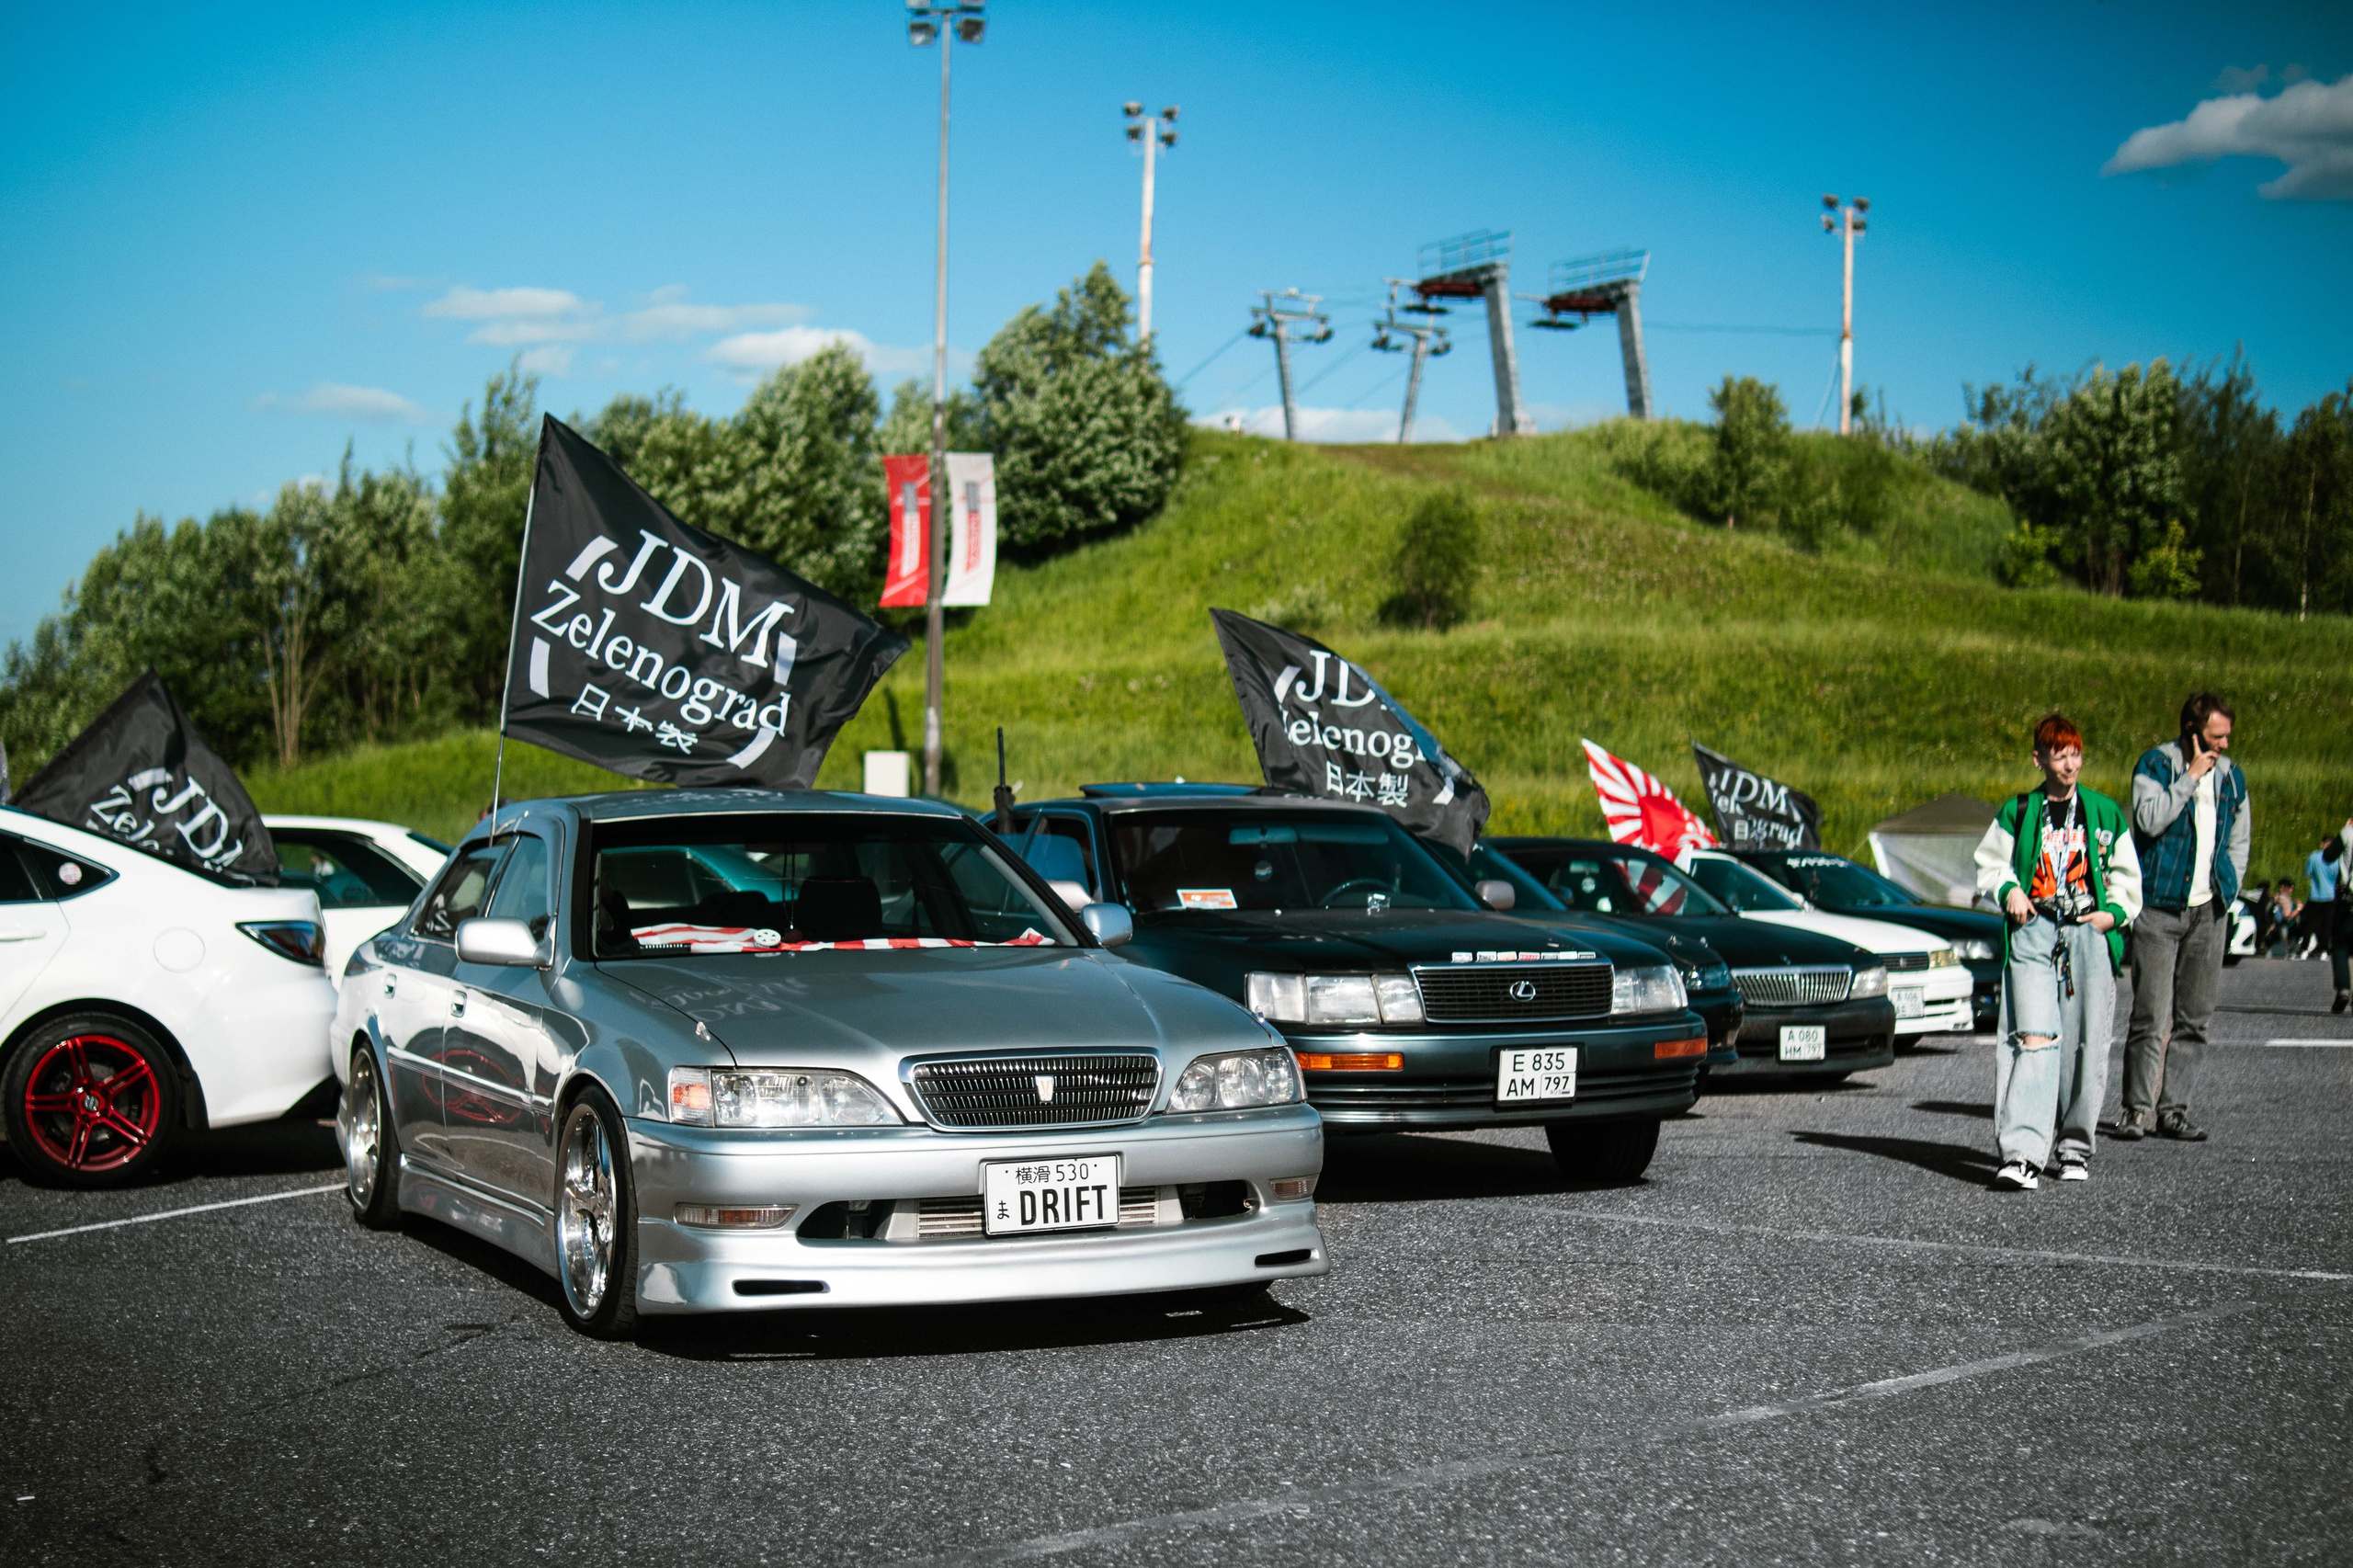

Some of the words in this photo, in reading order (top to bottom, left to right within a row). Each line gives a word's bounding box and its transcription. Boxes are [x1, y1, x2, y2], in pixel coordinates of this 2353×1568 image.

[596, 528, 795, 667] JDM
[530, 579, 790, 738] Zelenograd
[1325, 759, 1410, 808] 日本製
[1788, 1028, 1795, 1042] A
[1798, 1028, 1819, 1042] 080
[1513, 1054, 1526, 1072] E
[1532, 1052, 1565, 1071] 835
[1784, 1044, 1802, 1059] HM
[1506, 1077, 1535, 1097] AM
[1544, 1075, 1570, 1091] 797
[1015, 1165, 1051, 1185] 横滑
[1056, 1163, 1089, 1182] 530
[996, 1199, 1010, 1220] ま
[1019, 1184, 1108, 1226] DRIFT
